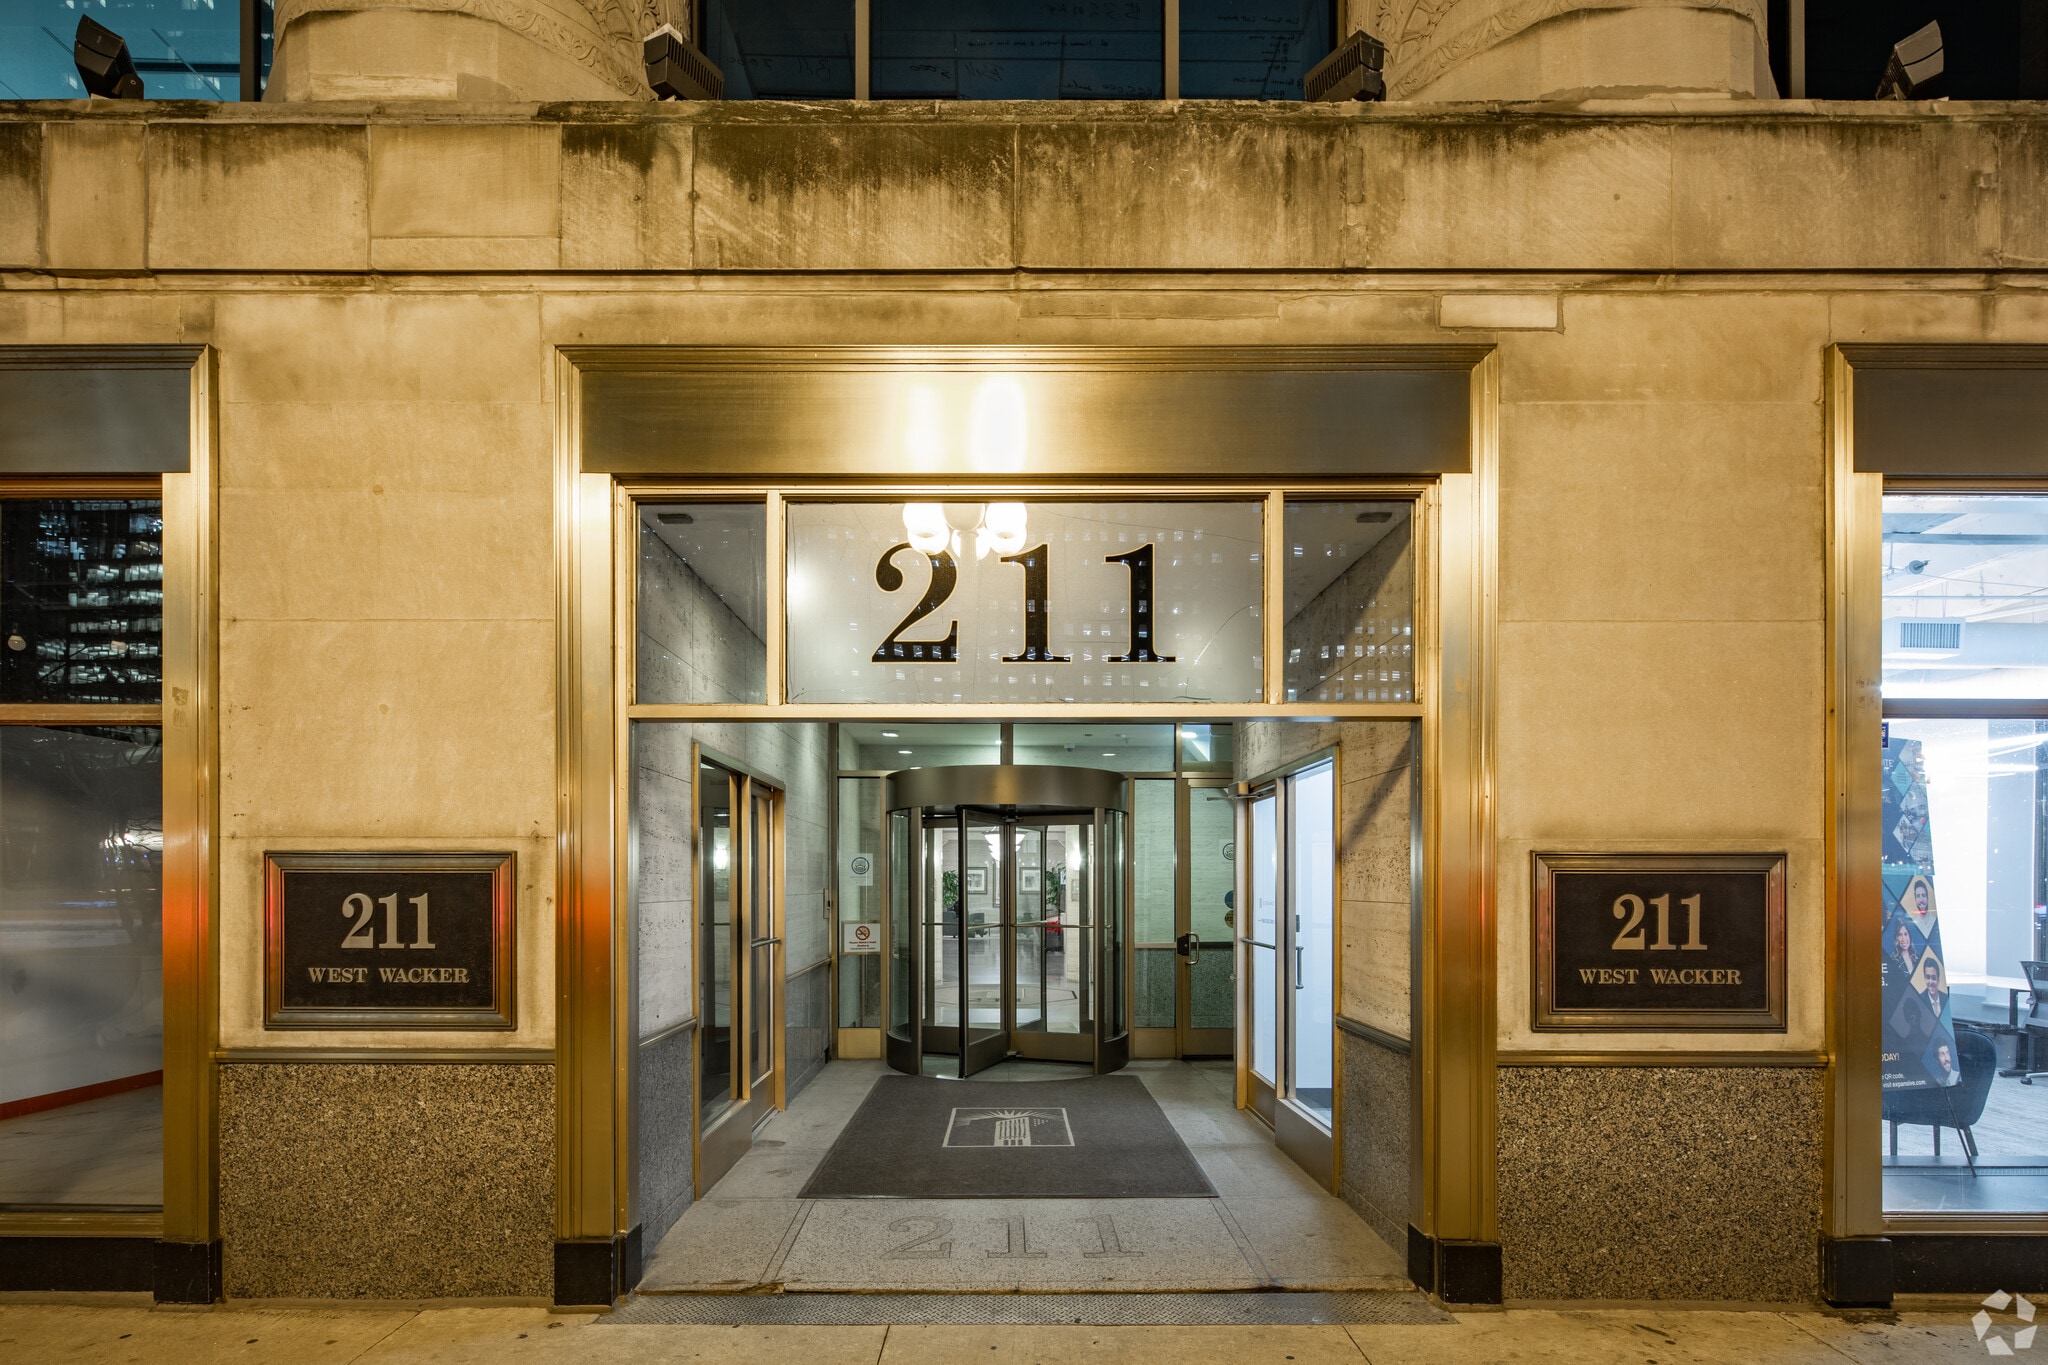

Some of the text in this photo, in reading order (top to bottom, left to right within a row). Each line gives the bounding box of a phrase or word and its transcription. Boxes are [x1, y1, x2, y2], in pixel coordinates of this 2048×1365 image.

[871, 542, 1177, 664] 211
[341, 892, 436, 949] 211
[1611, 893, 1708, 950] 211
[307, 966, 470, 984] WEST WACKER
[1579, 968, 1743, 985] WEST WACKER
[879, 1214, 1143, 1259] 211
